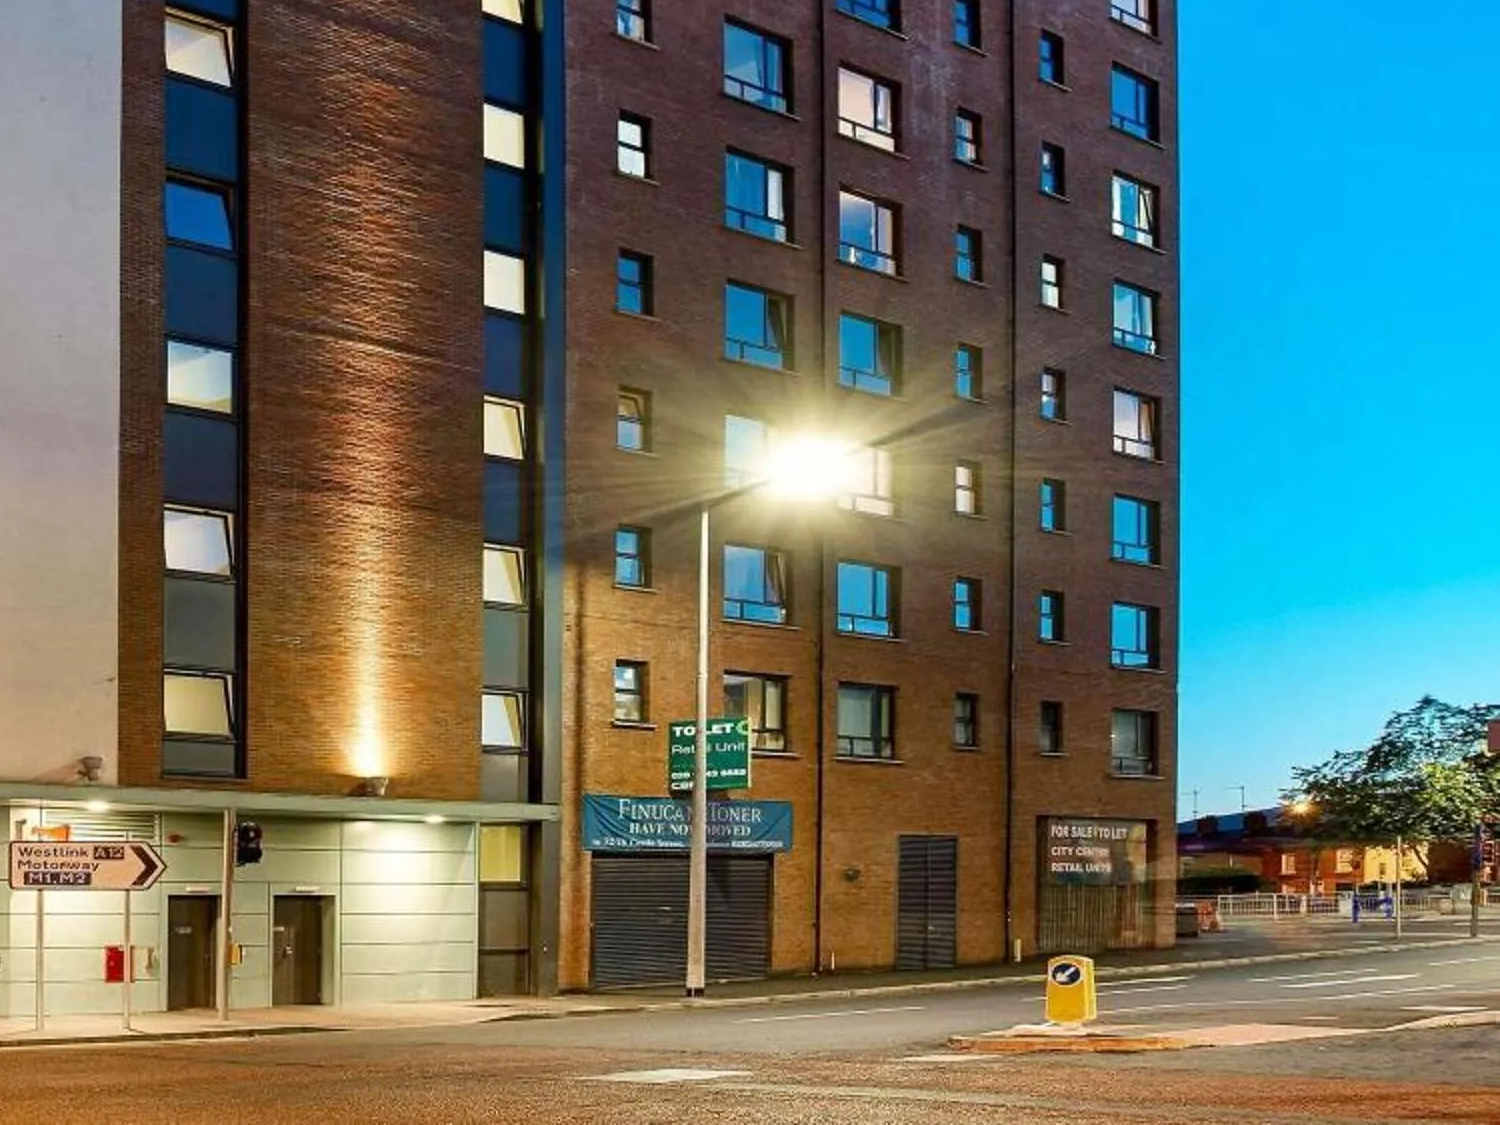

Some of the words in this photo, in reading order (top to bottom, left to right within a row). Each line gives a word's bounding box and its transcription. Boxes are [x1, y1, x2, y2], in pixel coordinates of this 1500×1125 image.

[672, 725, 696, 738] TO
[708, 801, 762, 824] TONER
[629, 822, 665, 834] HAVE
[18, 847, 88, 857] Westlink
[95, 847, 124, 858] A12
[17, 860, 100, 871] Motorway
